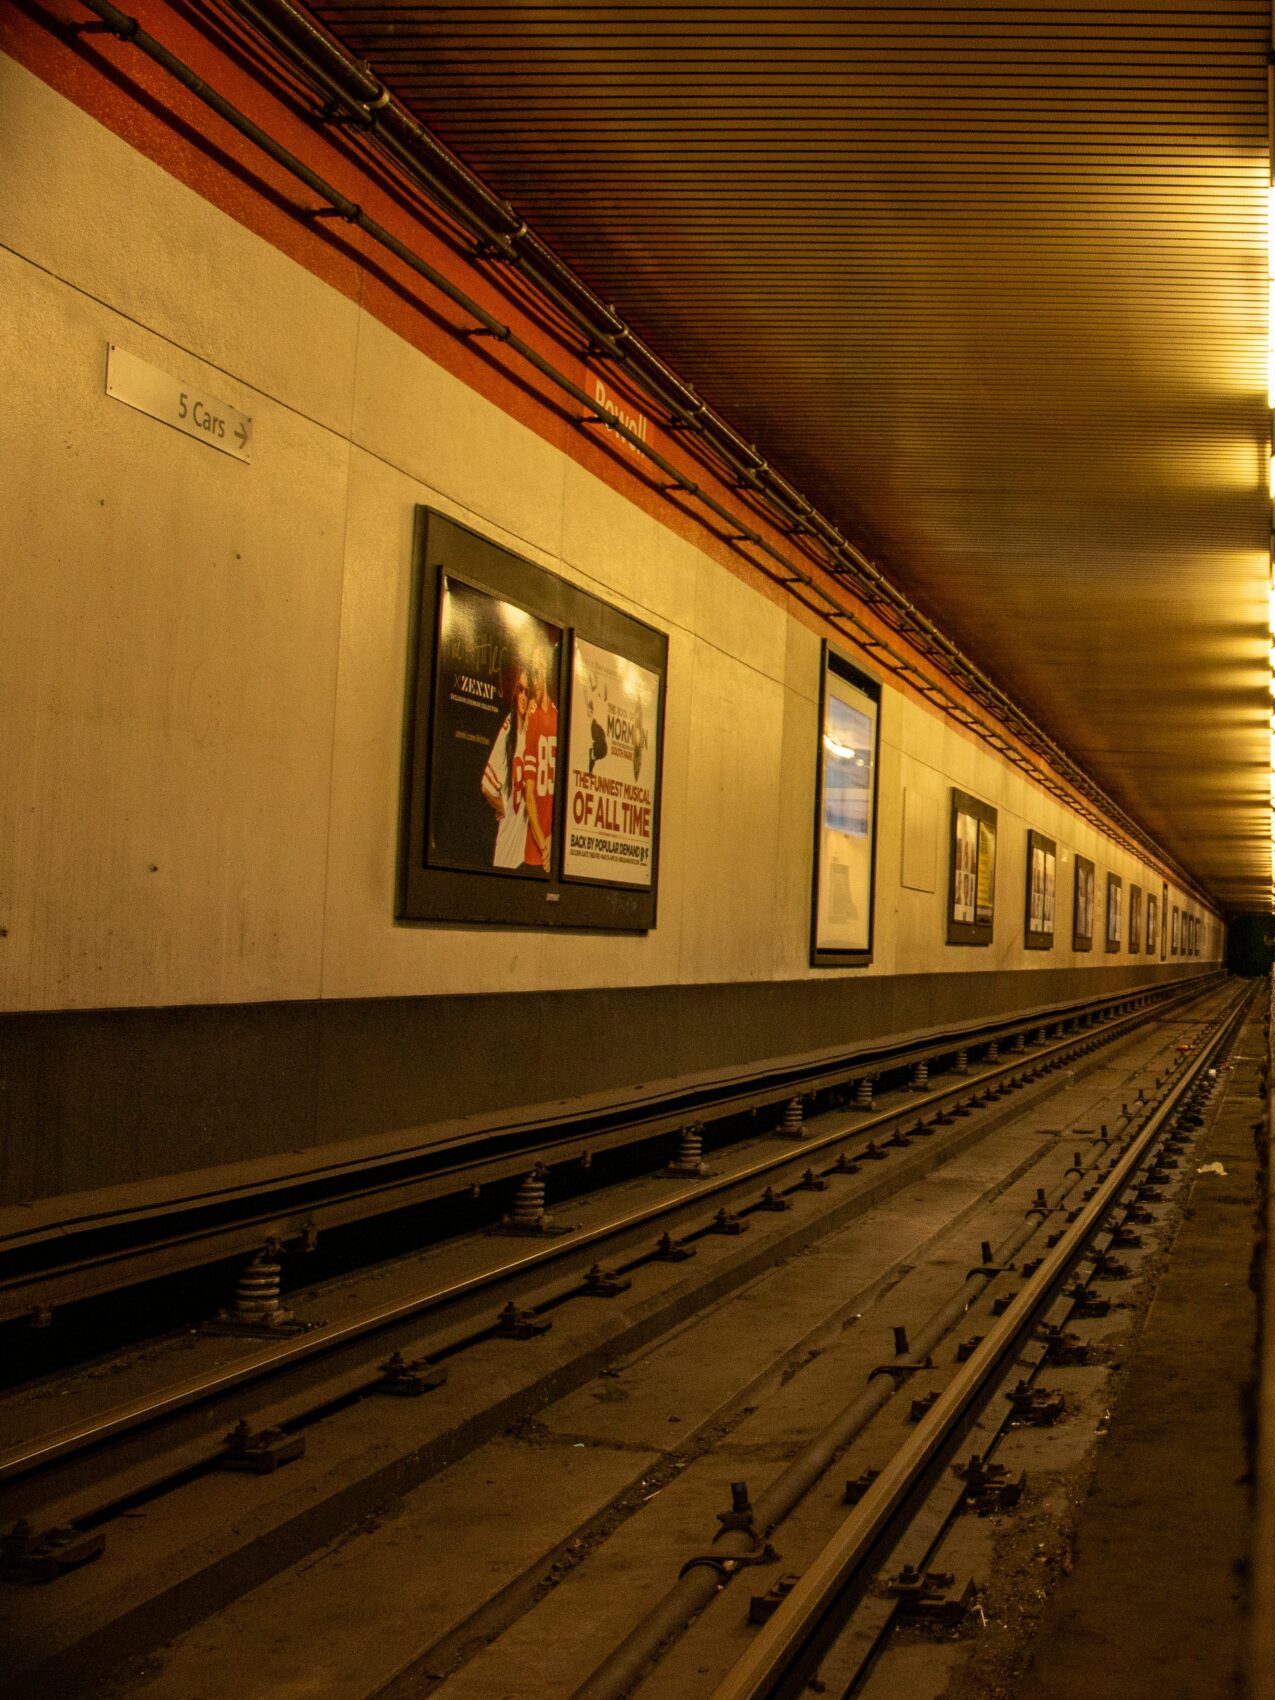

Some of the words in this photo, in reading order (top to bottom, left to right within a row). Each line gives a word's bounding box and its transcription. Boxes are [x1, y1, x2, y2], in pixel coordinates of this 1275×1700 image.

[179, 393, 188, 419] 5
[193, 401, 225, 438] Cars
[461, 675, 497, 700] ZENNI
[589, 773, 623, 799] FUNNIEST
[624, 783, 651, 805] MUSICAL
[573, 791, 594, 825] OF
[594, 796, 620, 832] ALL
[622, 802, 651, 838] TIME
[571, 834, 587, 848] BACK
[587, 836, 594, 850] BY
[595, 838, 619, 855] POPULAR
[620, 842, 640, 858] DEMAND
